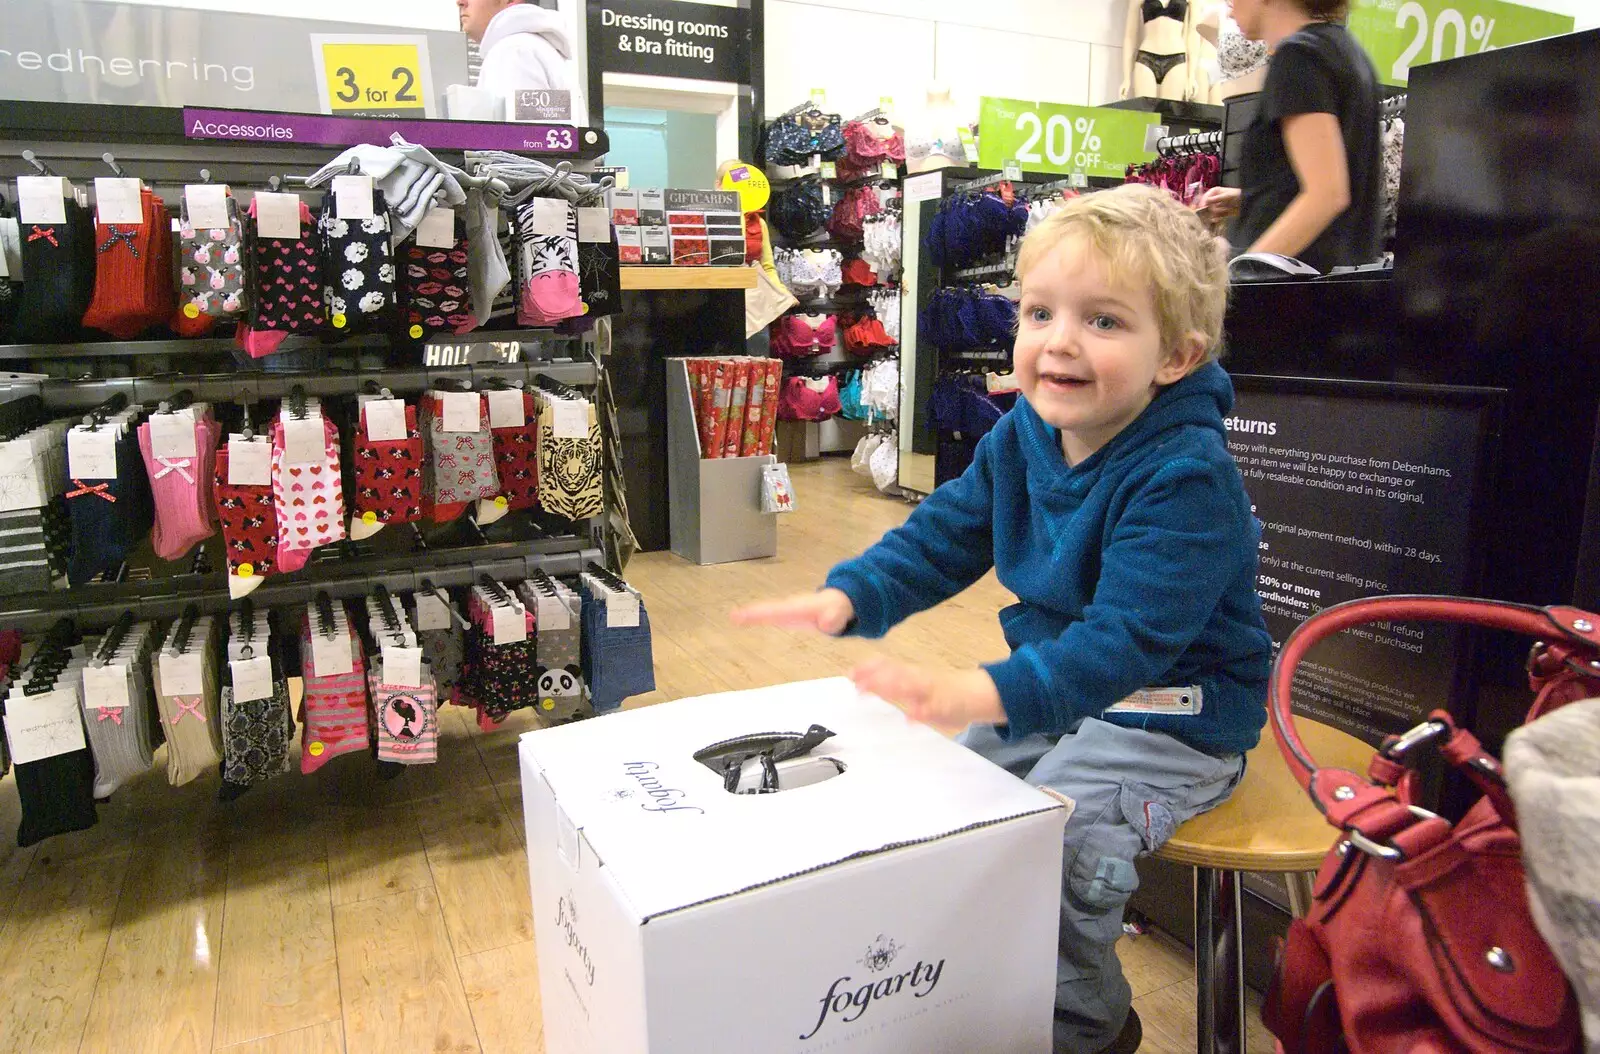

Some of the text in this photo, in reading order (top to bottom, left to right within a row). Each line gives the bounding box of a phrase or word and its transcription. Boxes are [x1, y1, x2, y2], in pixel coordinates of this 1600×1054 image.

[601, 9, 728, 38] Dressing rooms
[618, 34, 714, 63] & Bra fitting
[336, 66, 417, 103] 3 for 2
[520, 91, 550, 107] £50
[192, 120, 293, 139] Accessories
[523, 129, 573, 149] from £3
[1075, 152, 1101, 168] OFF
[748, 180, 767, 189] FREE
[670, 192, 733, 205] GIFTCARDS
[1222, 416, 1277, 436] eturns
[1227, 440, 1452, 478] happy with everything you purchase from Debenhams.
[1250, 457, 1260, 465] an
[1261, 458, 1278, 468] item
[1279, 461, 1291, 470] we
[1293, 462, 1307, 472] will
[1307, 464, 1319, 473] be
[1320, 465, 1346, 480] happy
[1348, 470, 1357, 479] to
[1359, 472, 1402, 487] exchange
[1404, 478, 1416, 486] or
[1244, 469, 1249, 477] a
[1250, 468, 1265, 480] fully
[1266, 472, 1304, 485] resaleable
[1305, 478, 1345, 491] condition
[1346, 484, 1363, 494] and
[1364, 486, 1373, 495] in
[1375, 487, 1386, 498] its
[1388, 490, 1425, 504] original,
[1268, 521, 1297, 534] original
[1297, 527, 1334, 541] payment
[1335, 534, 1372, 550] method)
[1374, 542, 1402, 555] within
[1404, 546, 1417, 558] 28
[1418, 549, 1442, 563] days.
[1259, 575, 1321, 598] 50% or more
[1262, 555, 1389, 592] only) at the current selling price.
[1257, 589, 1310, 610] cardholders:
[1278, 607, 1291, 618] the
[1352, 628, 1423, 654] were purchased
[1392, 624, 1424, 640] refund
[623, 761, 705, 814] fogarty
[555, 896, 595, 987] fogarty
[799, 959, 945, 1040] fogarty
